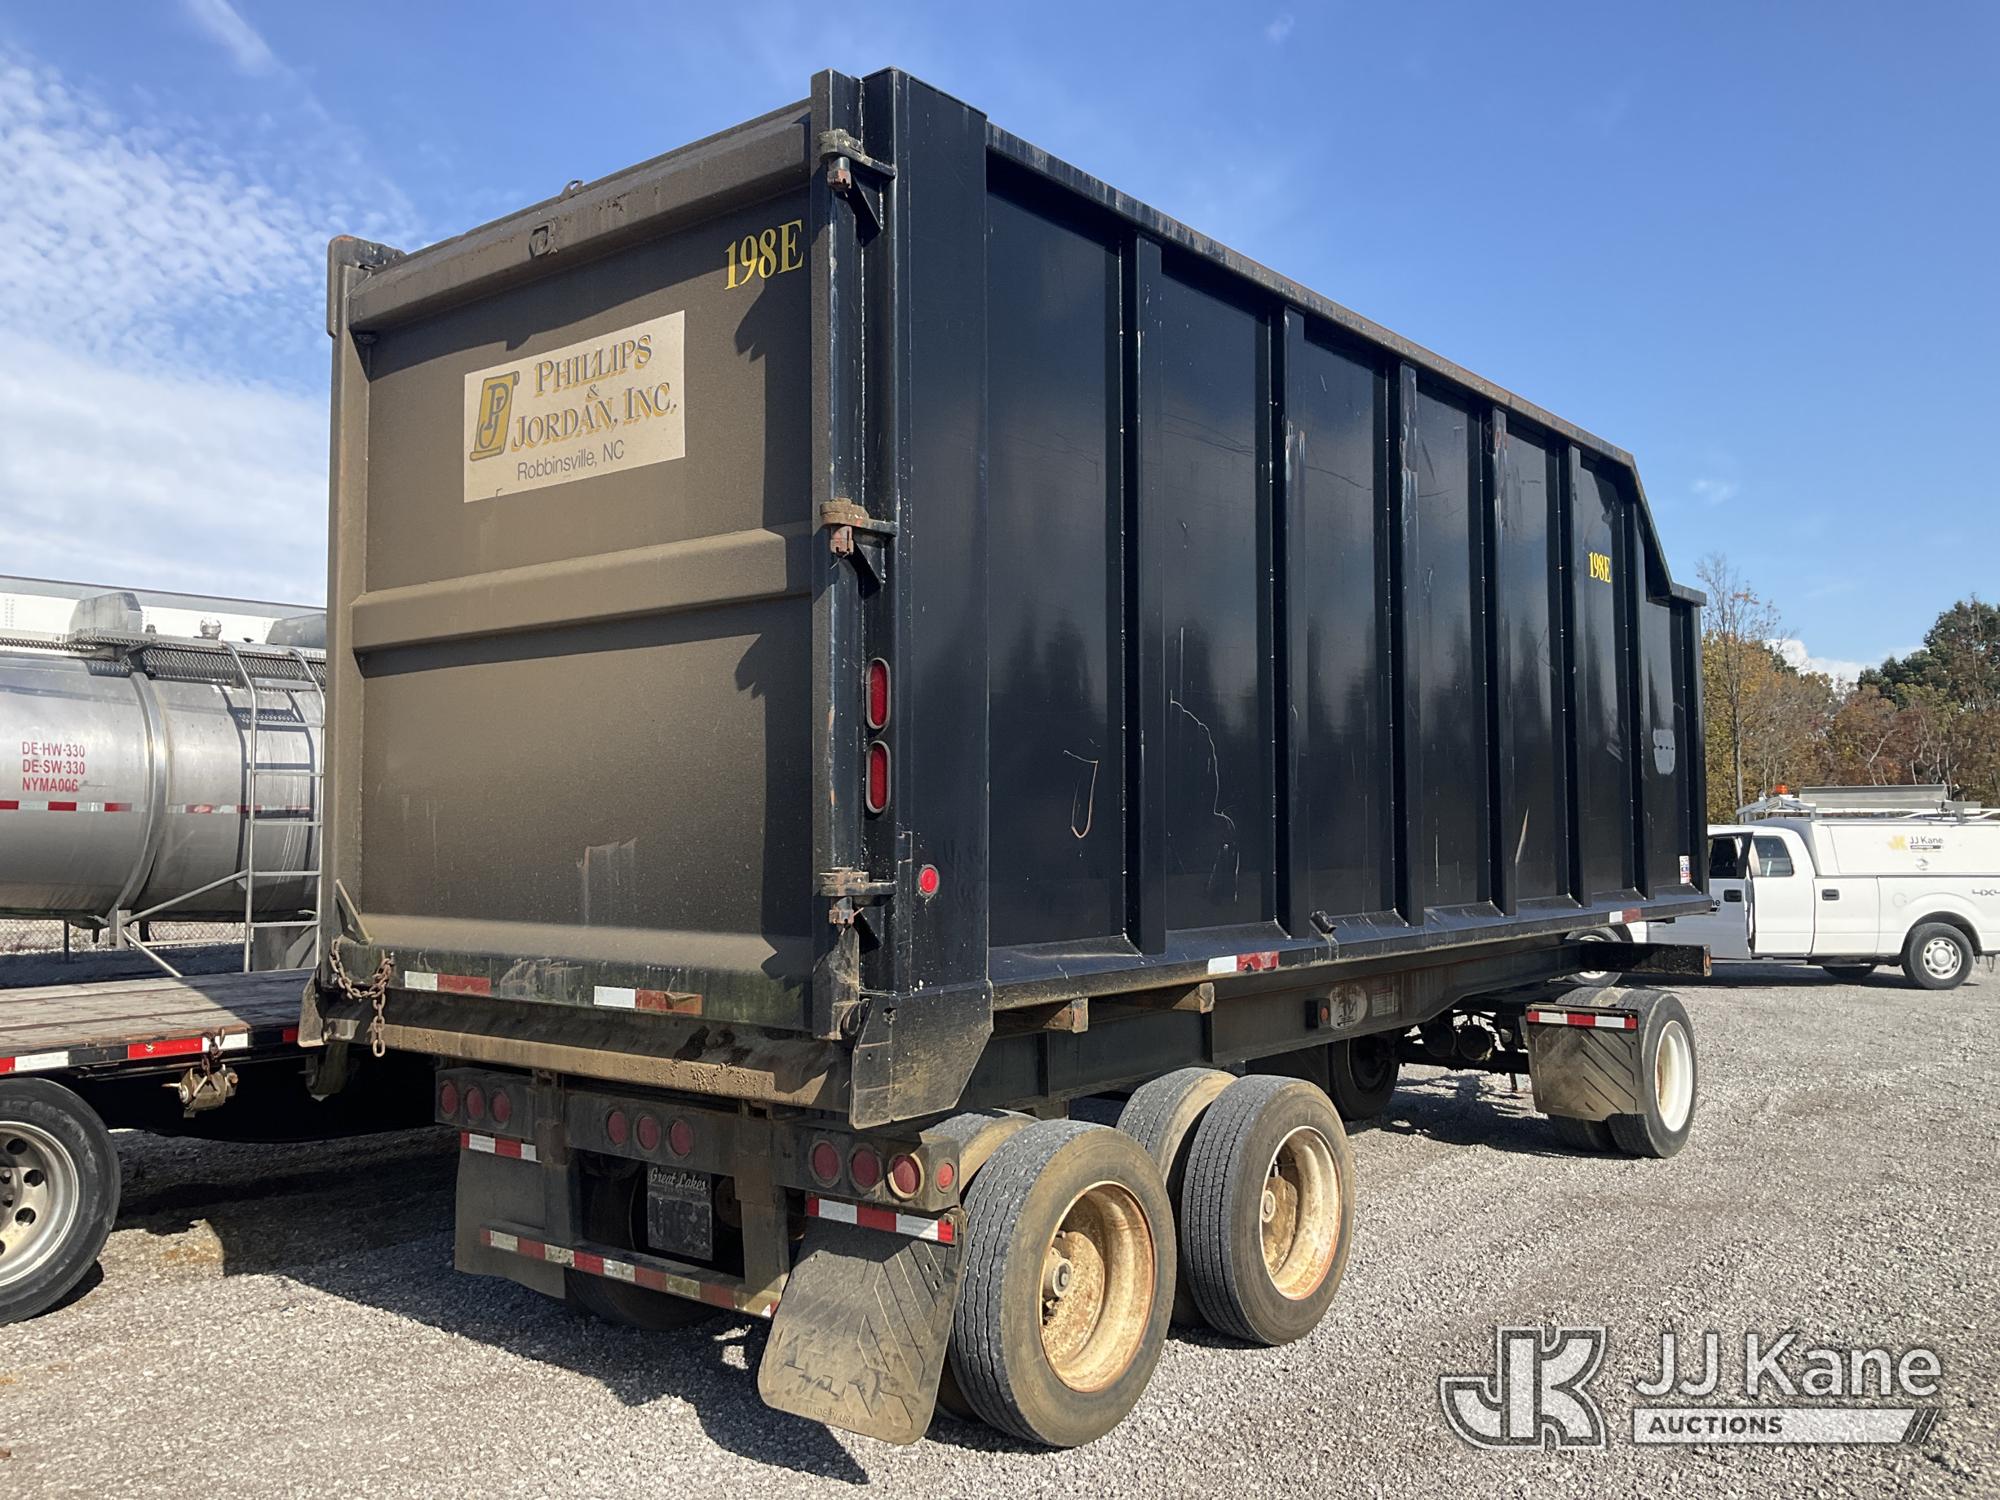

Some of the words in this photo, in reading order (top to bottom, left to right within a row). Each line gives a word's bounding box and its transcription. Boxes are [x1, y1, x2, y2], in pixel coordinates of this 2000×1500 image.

[724, 219, 804, 290] 198E
[534, 334, 653, 398] PHILLIPS
[586, 384, 600, 403] &
[511, 397, 619, 452] JORDAN,
[622, 382, 678, 426] INC.
[517, 449, 598, 481] Robbinsville,
[602, 439, 625, 463] NC
[1588, 551, 1612, 583] 198E
[22, 741, 85, 758] DE-HW-330
[22, 759, 86, 775] DE-SW-330
[1920, 836, 1944, 845] Kane
[649, 1167, 676, 1186] Great
[675, 1173, 706, 1192] Lakes
